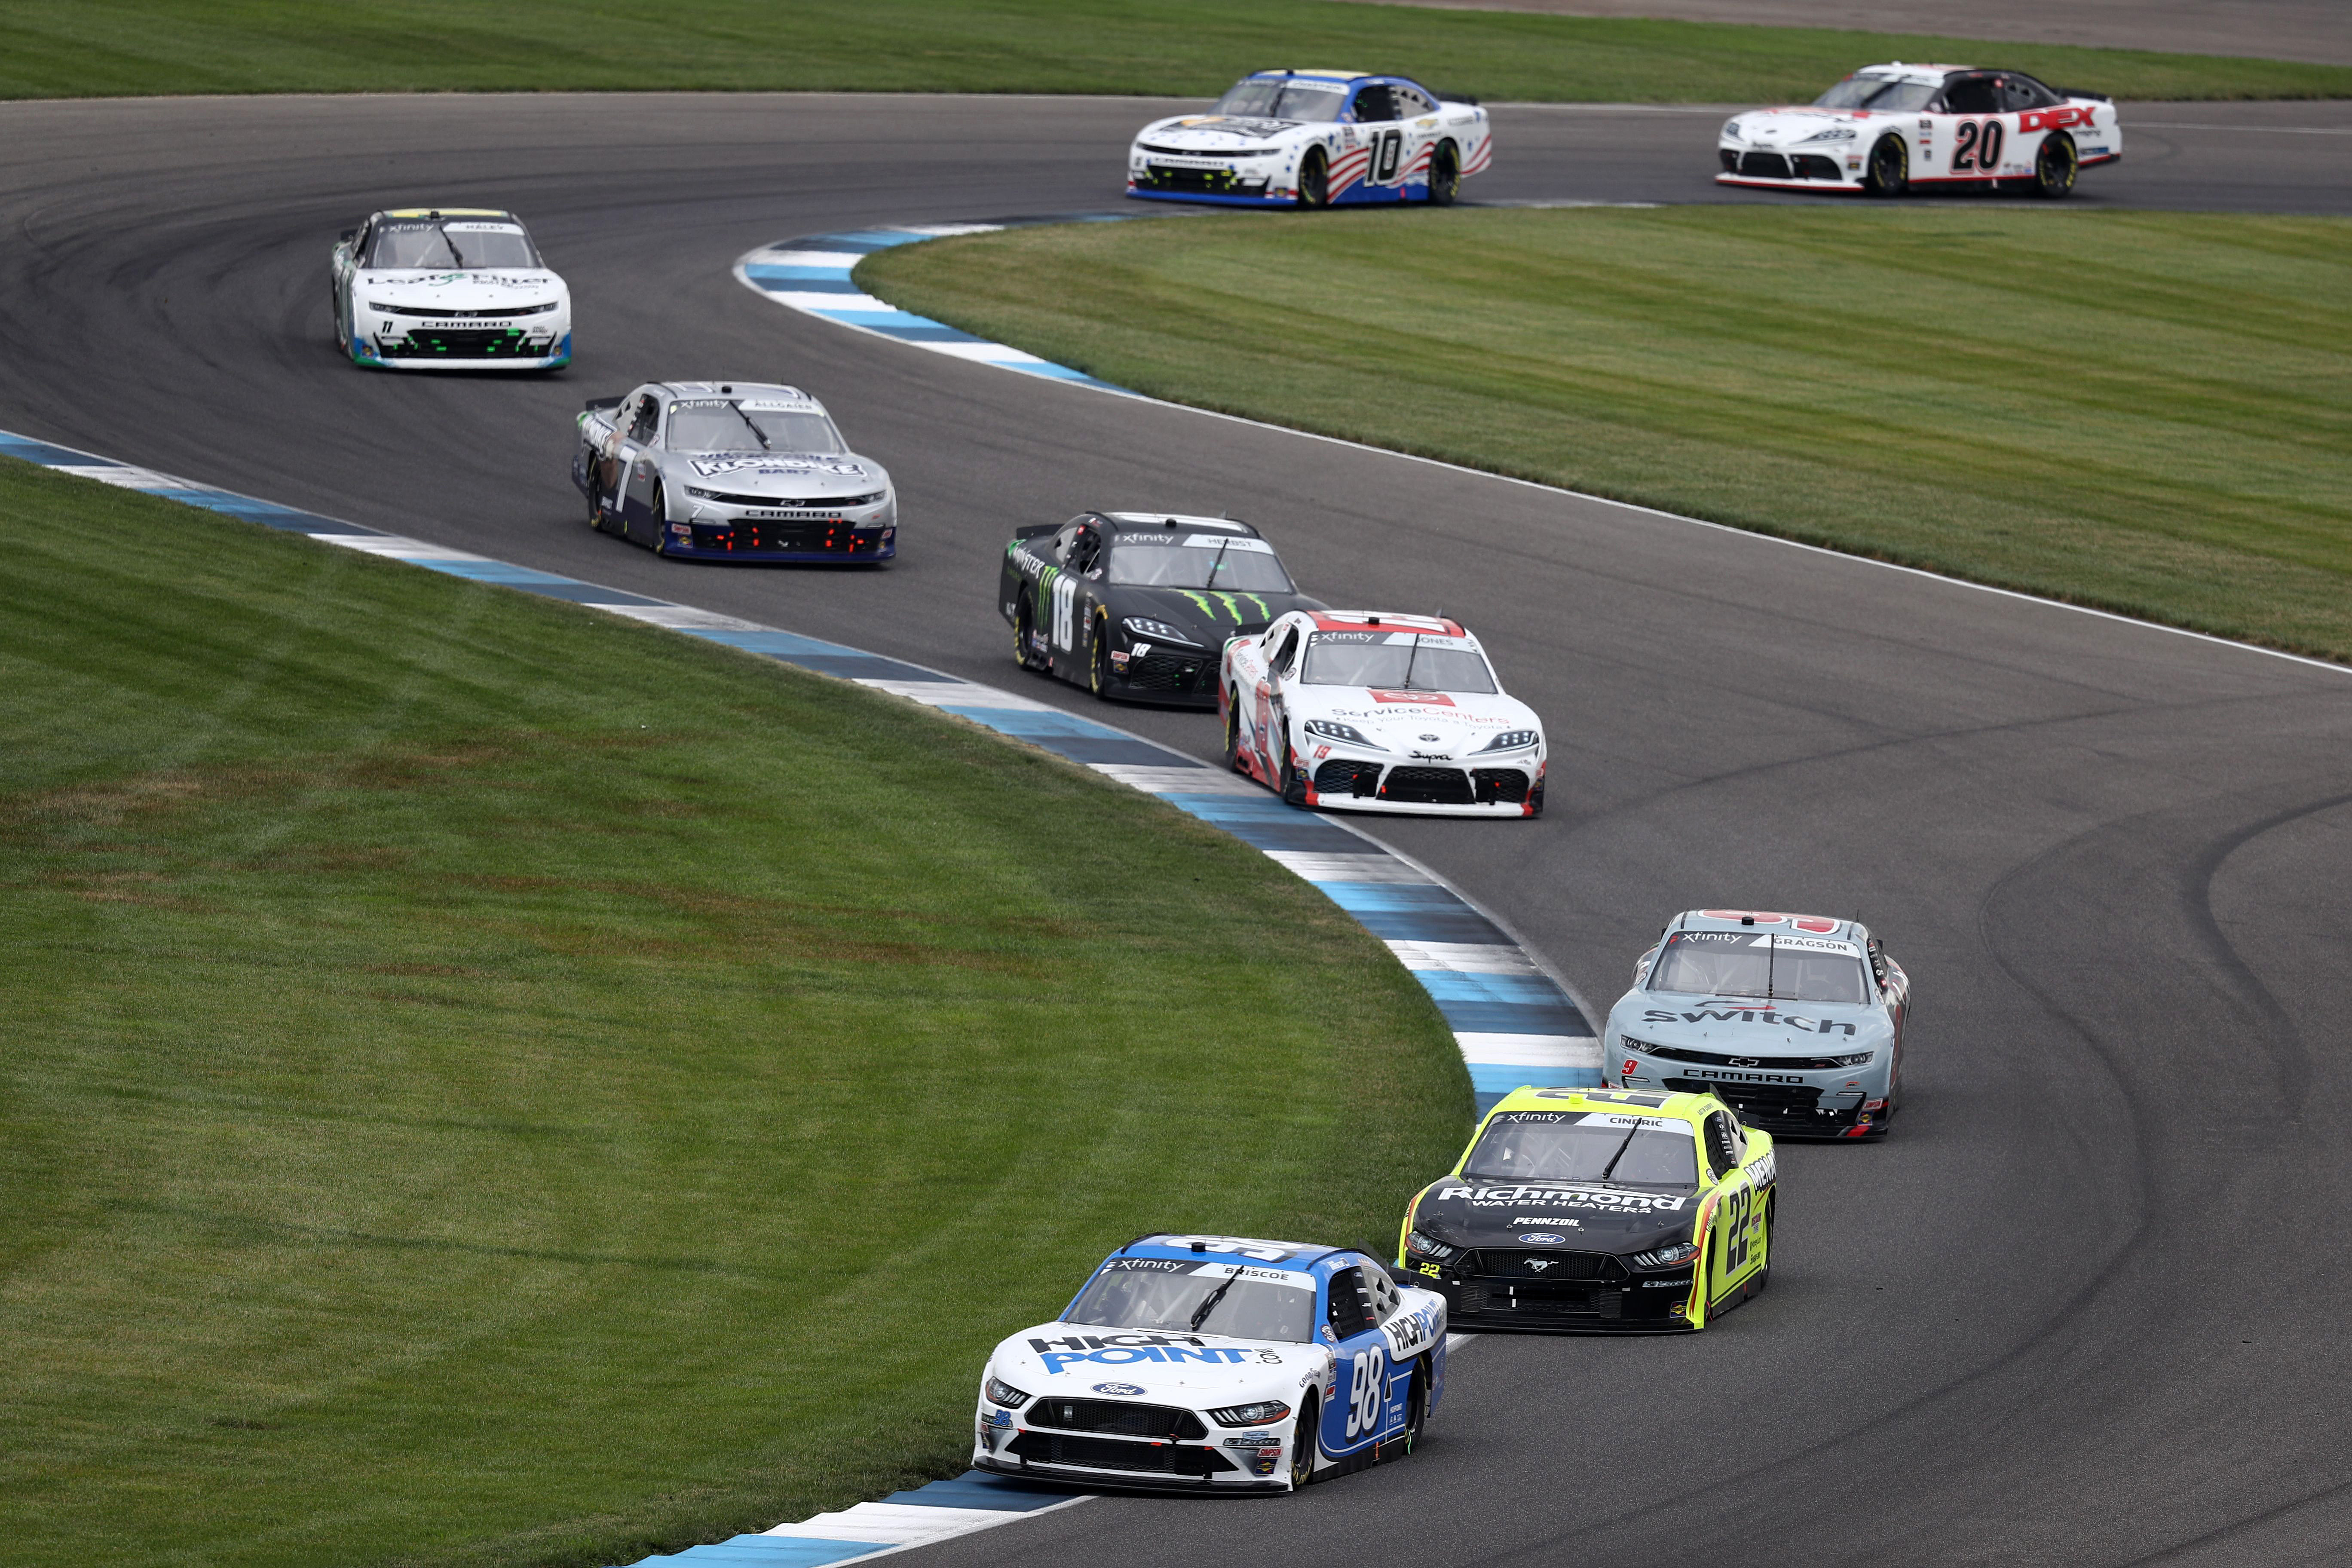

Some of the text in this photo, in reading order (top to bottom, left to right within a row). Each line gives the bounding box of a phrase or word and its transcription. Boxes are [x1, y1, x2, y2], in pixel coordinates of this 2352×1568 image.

[1952, 120, 2004, 171] 20
[1366, 129, 1402, 183] 10
[382, 321, 393, 333] 11
[680, 399, 730, 409] xfinity
[689, 459, 864, 477] KLONDIKE
[616, 445, 637, 513] 7
[691, 504, 705, 519] 7
[745, 510, 842, 518] CAMARO
[1123, 533, 1174, 545] xfinity
[1052, 574, 1077, 653] 18
[1321, 631, 1375, 642] xfinity
[1130, 642, 1152, 658] 18
[1313, 745, 1332, 760] 19
[1408, 750, 1454, 763] Supra
[1682, 931, 1743, 944] xfinity
[1773, 937, 1848, 951] GRAGSON
[1621, 1059, 1639, 1075] 9
[1683, 1069, 1804, 1084] CAMARO
[1507, 1112, 1566, 1124] xfinity
[1609, 1117, 1663, 1127] CINDRIC
[1438, 1186, 1687, 1211] Richmond
[1552, 1200, 1652, 1213] HEATERS
[1513, 1217, 1580, 1227] PENNZOIL
[1726, 1182, 1751, 1275] 22
[1527, 1234, 1556, 1243] Ford
[1118, 1258, 1185, 1273] xfinity
[1419, 1262, 1440, 1279] 22
[1224, 1267, 1289, 1280] BRISCOE
[1027, 1335, 1207, 1354] HIGH
[1039, 1346, 1253, 1375] POINT
[1099, 1383, 1137, 1395] Ford
[1346, 1346, 1384, 1438] 98
